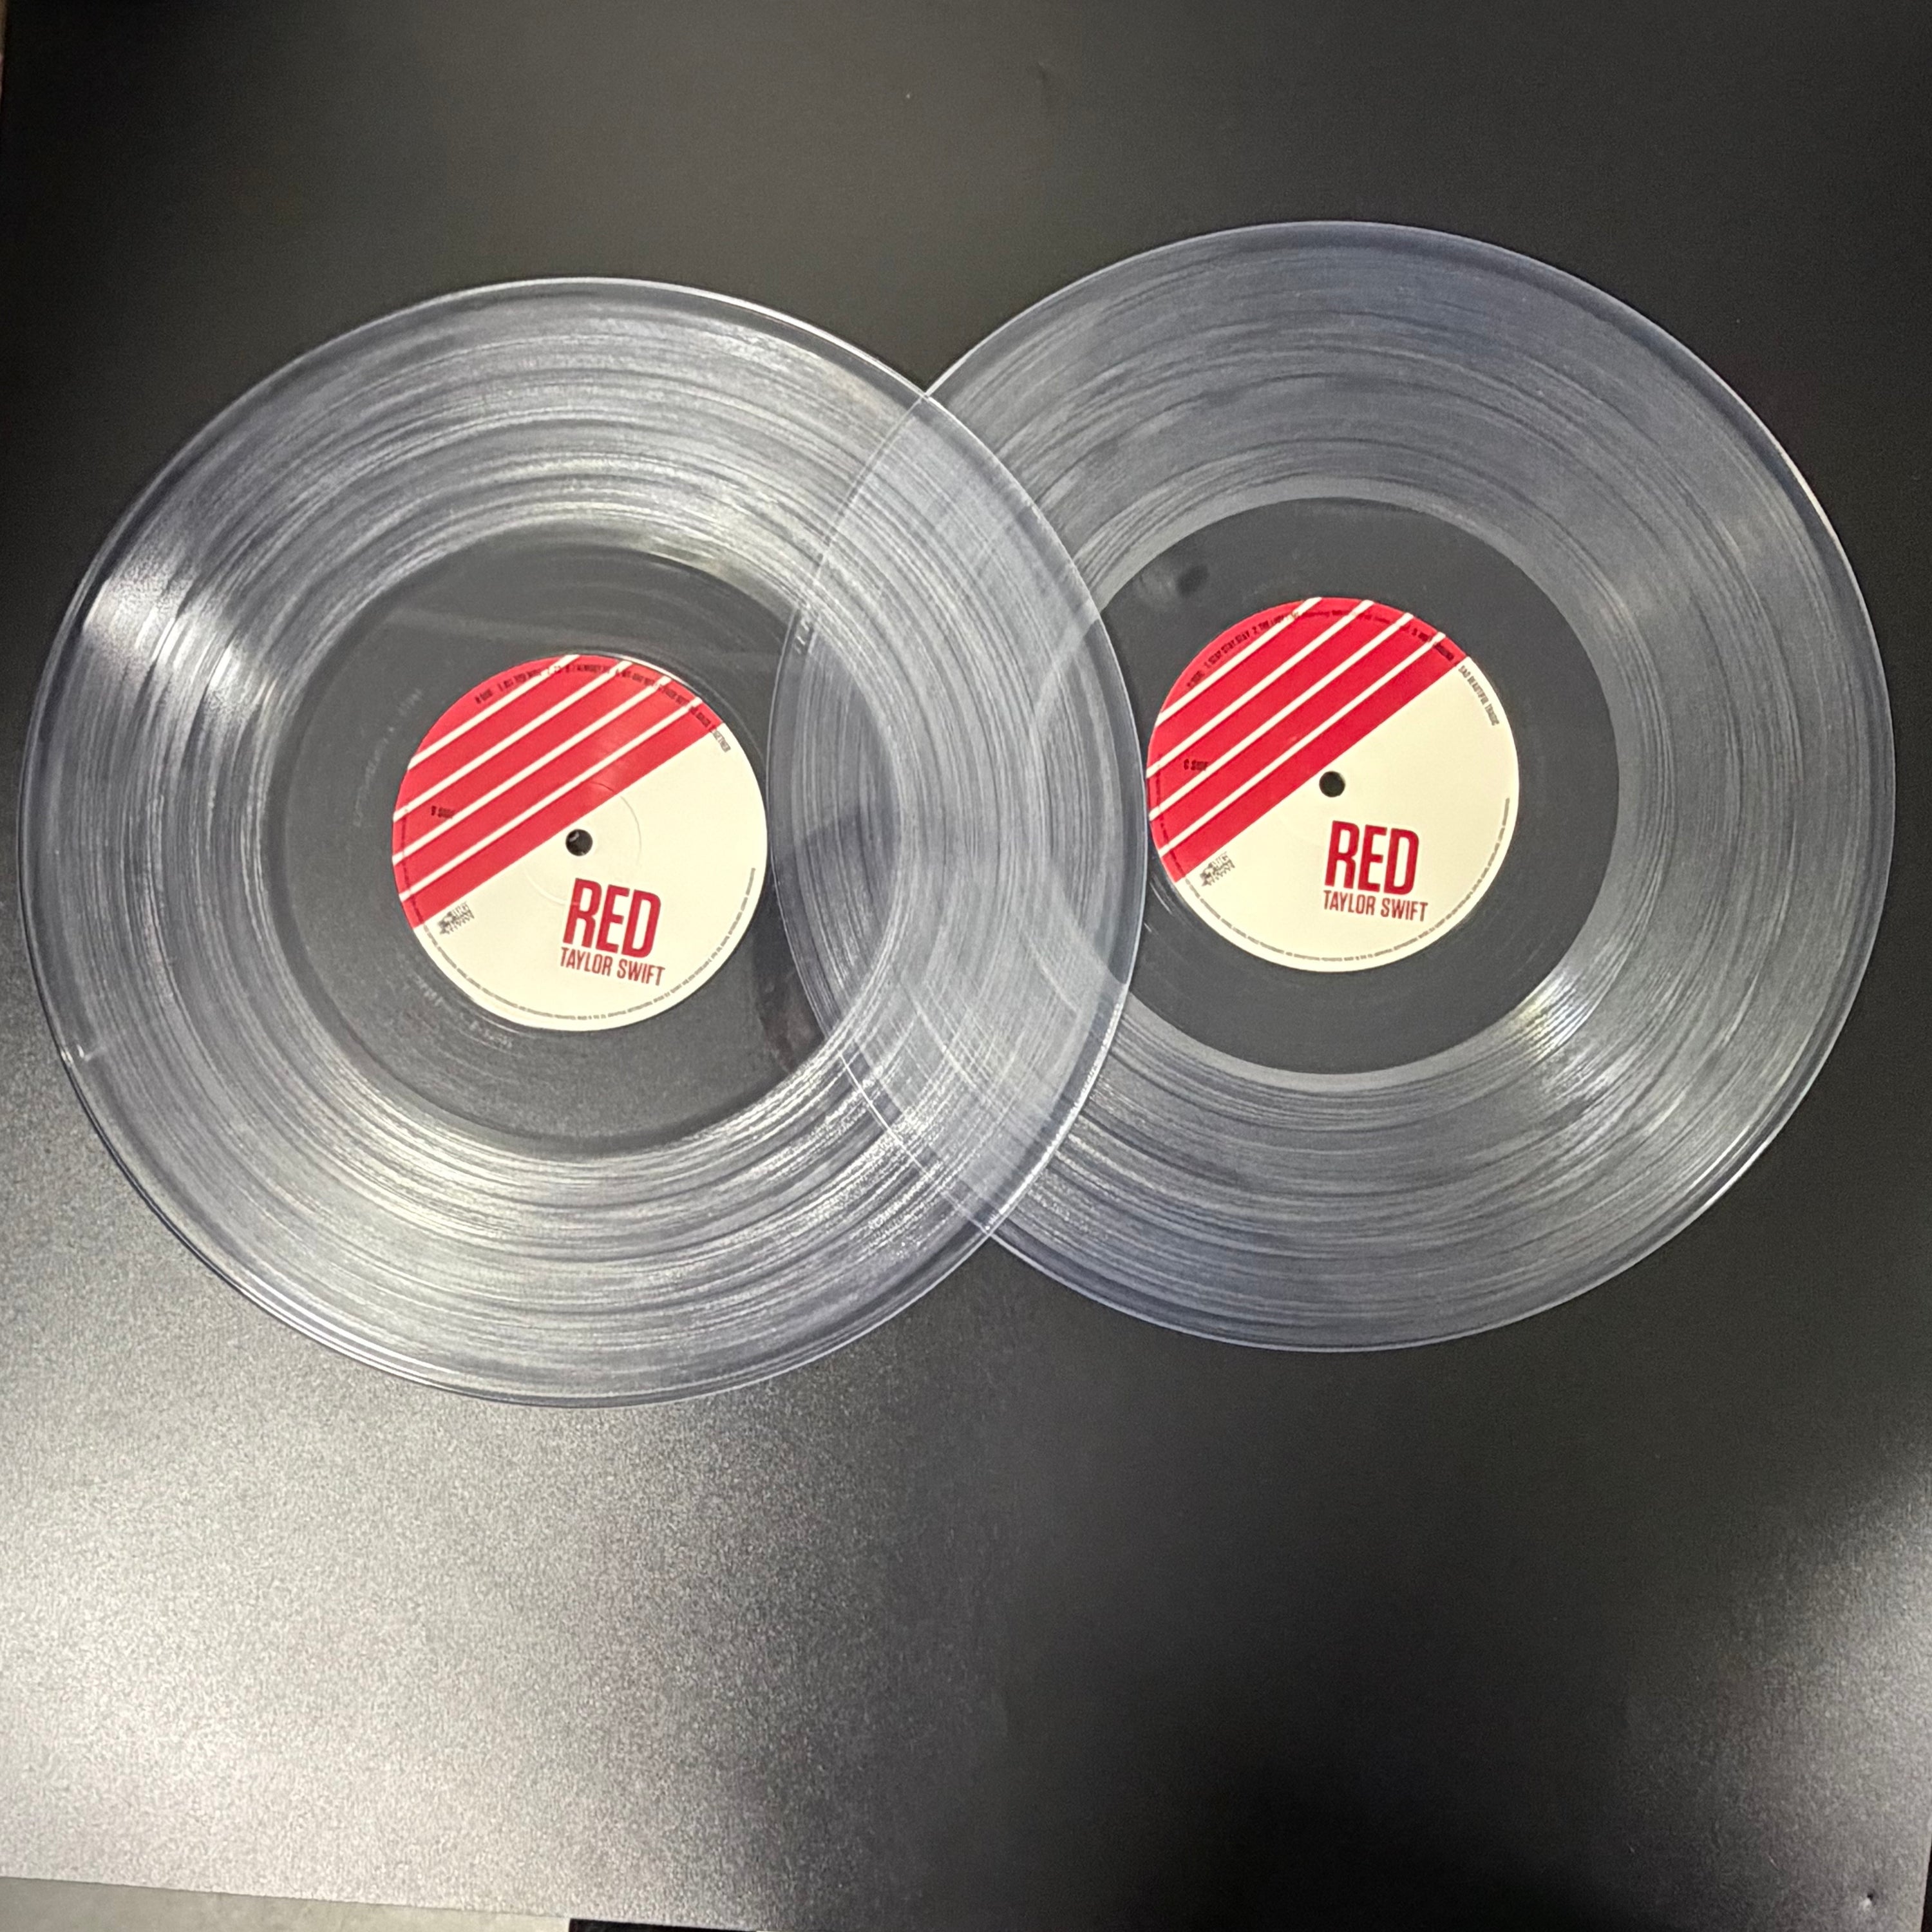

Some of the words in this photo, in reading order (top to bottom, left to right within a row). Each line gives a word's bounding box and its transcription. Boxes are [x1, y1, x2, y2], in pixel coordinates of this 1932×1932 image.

[1325, 820, 1419, 895] RED
[562, 877, 661, 958] RED
[1323, 890, 1376, 916] TAYLOR
[1380, 897, 1428, 922] SWIFT
[560, 947, 613, 976] TAYLOR
[617, 958, 666, 986] SWIFT
